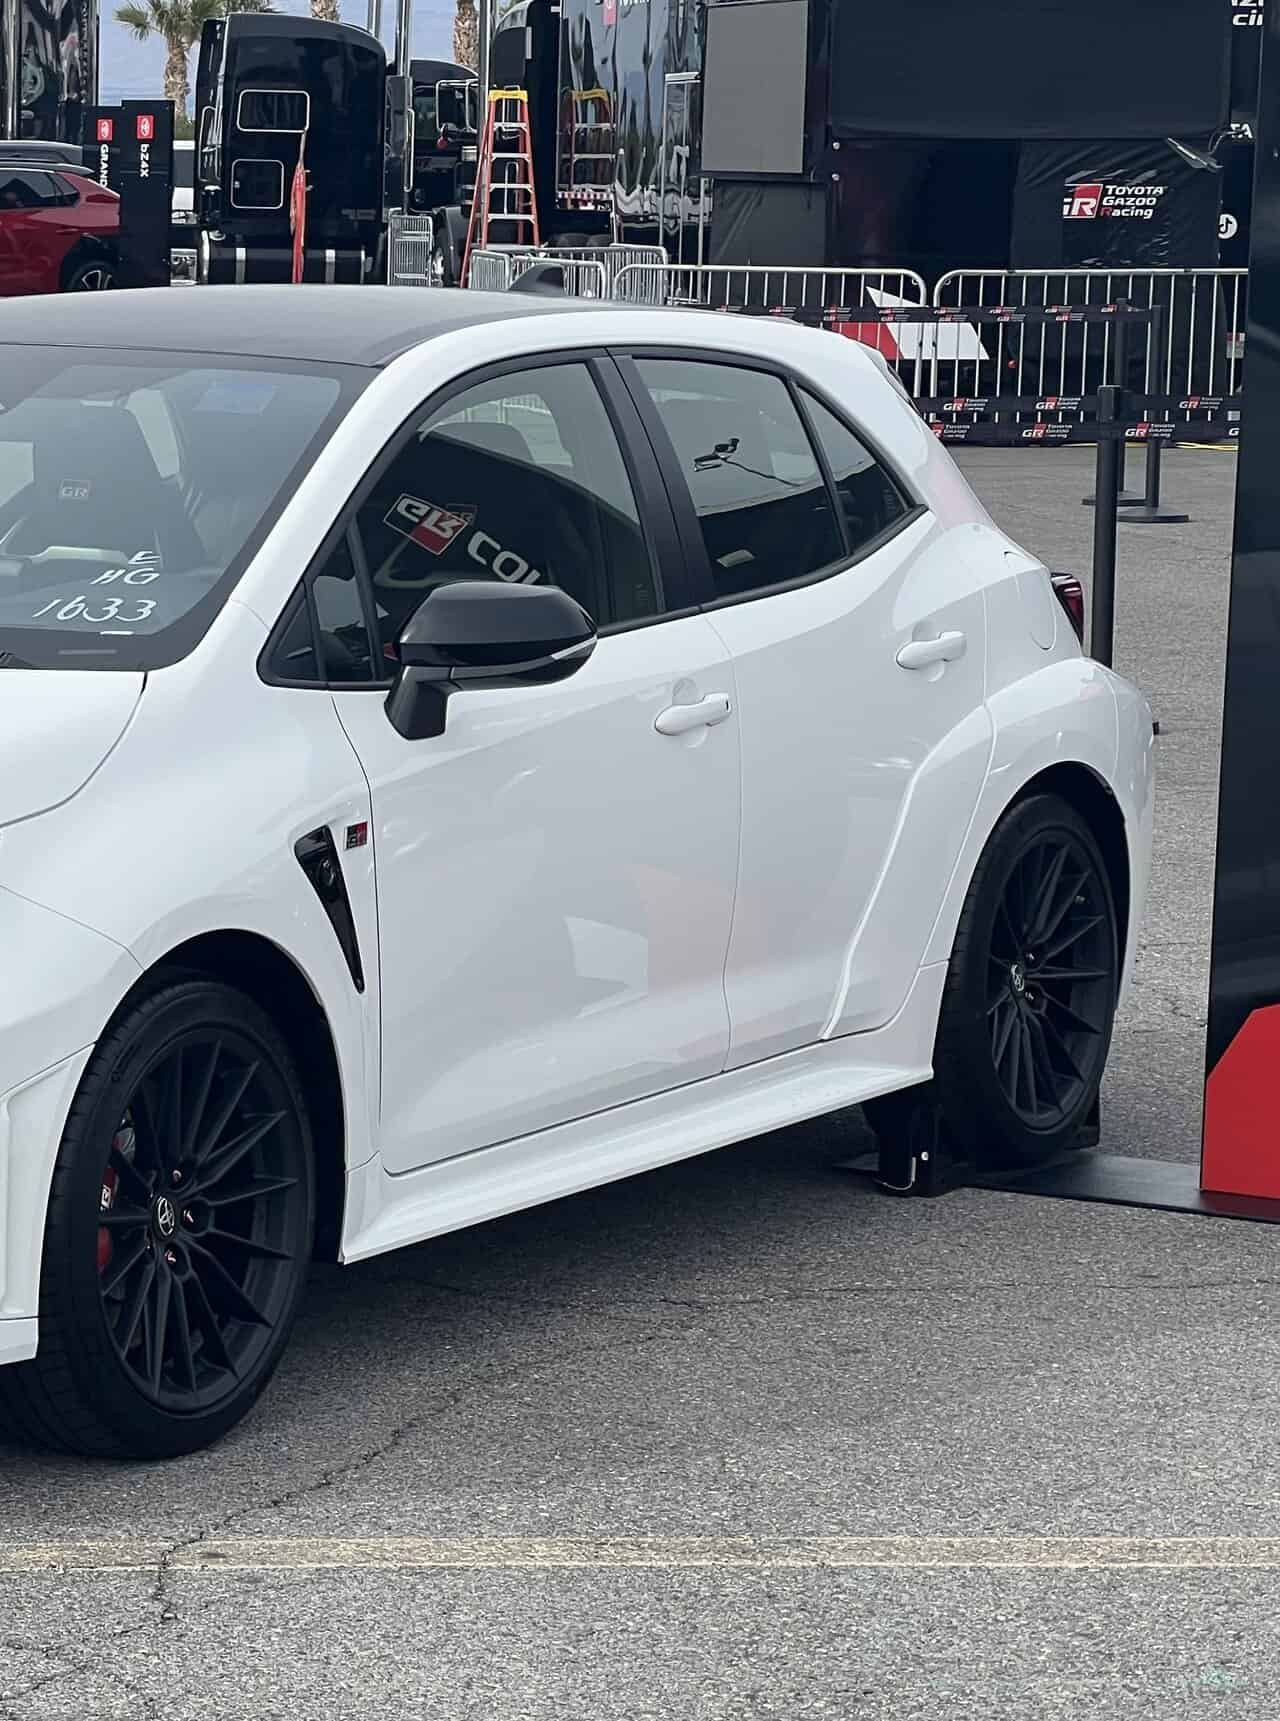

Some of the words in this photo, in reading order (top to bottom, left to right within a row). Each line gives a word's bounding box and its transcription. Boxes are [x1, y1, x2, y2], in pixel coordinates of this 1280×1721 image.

[100, 143, 109, 188] GRAND
[140, 143, 150, 178] bZ4X
[1105, 185, 1164, 196] TOYOTA
[1102, 196, 1157, 207] GAZOO
[1100, 206, 1154, 219] Racing
[32, 595, 158, 622] 1633
